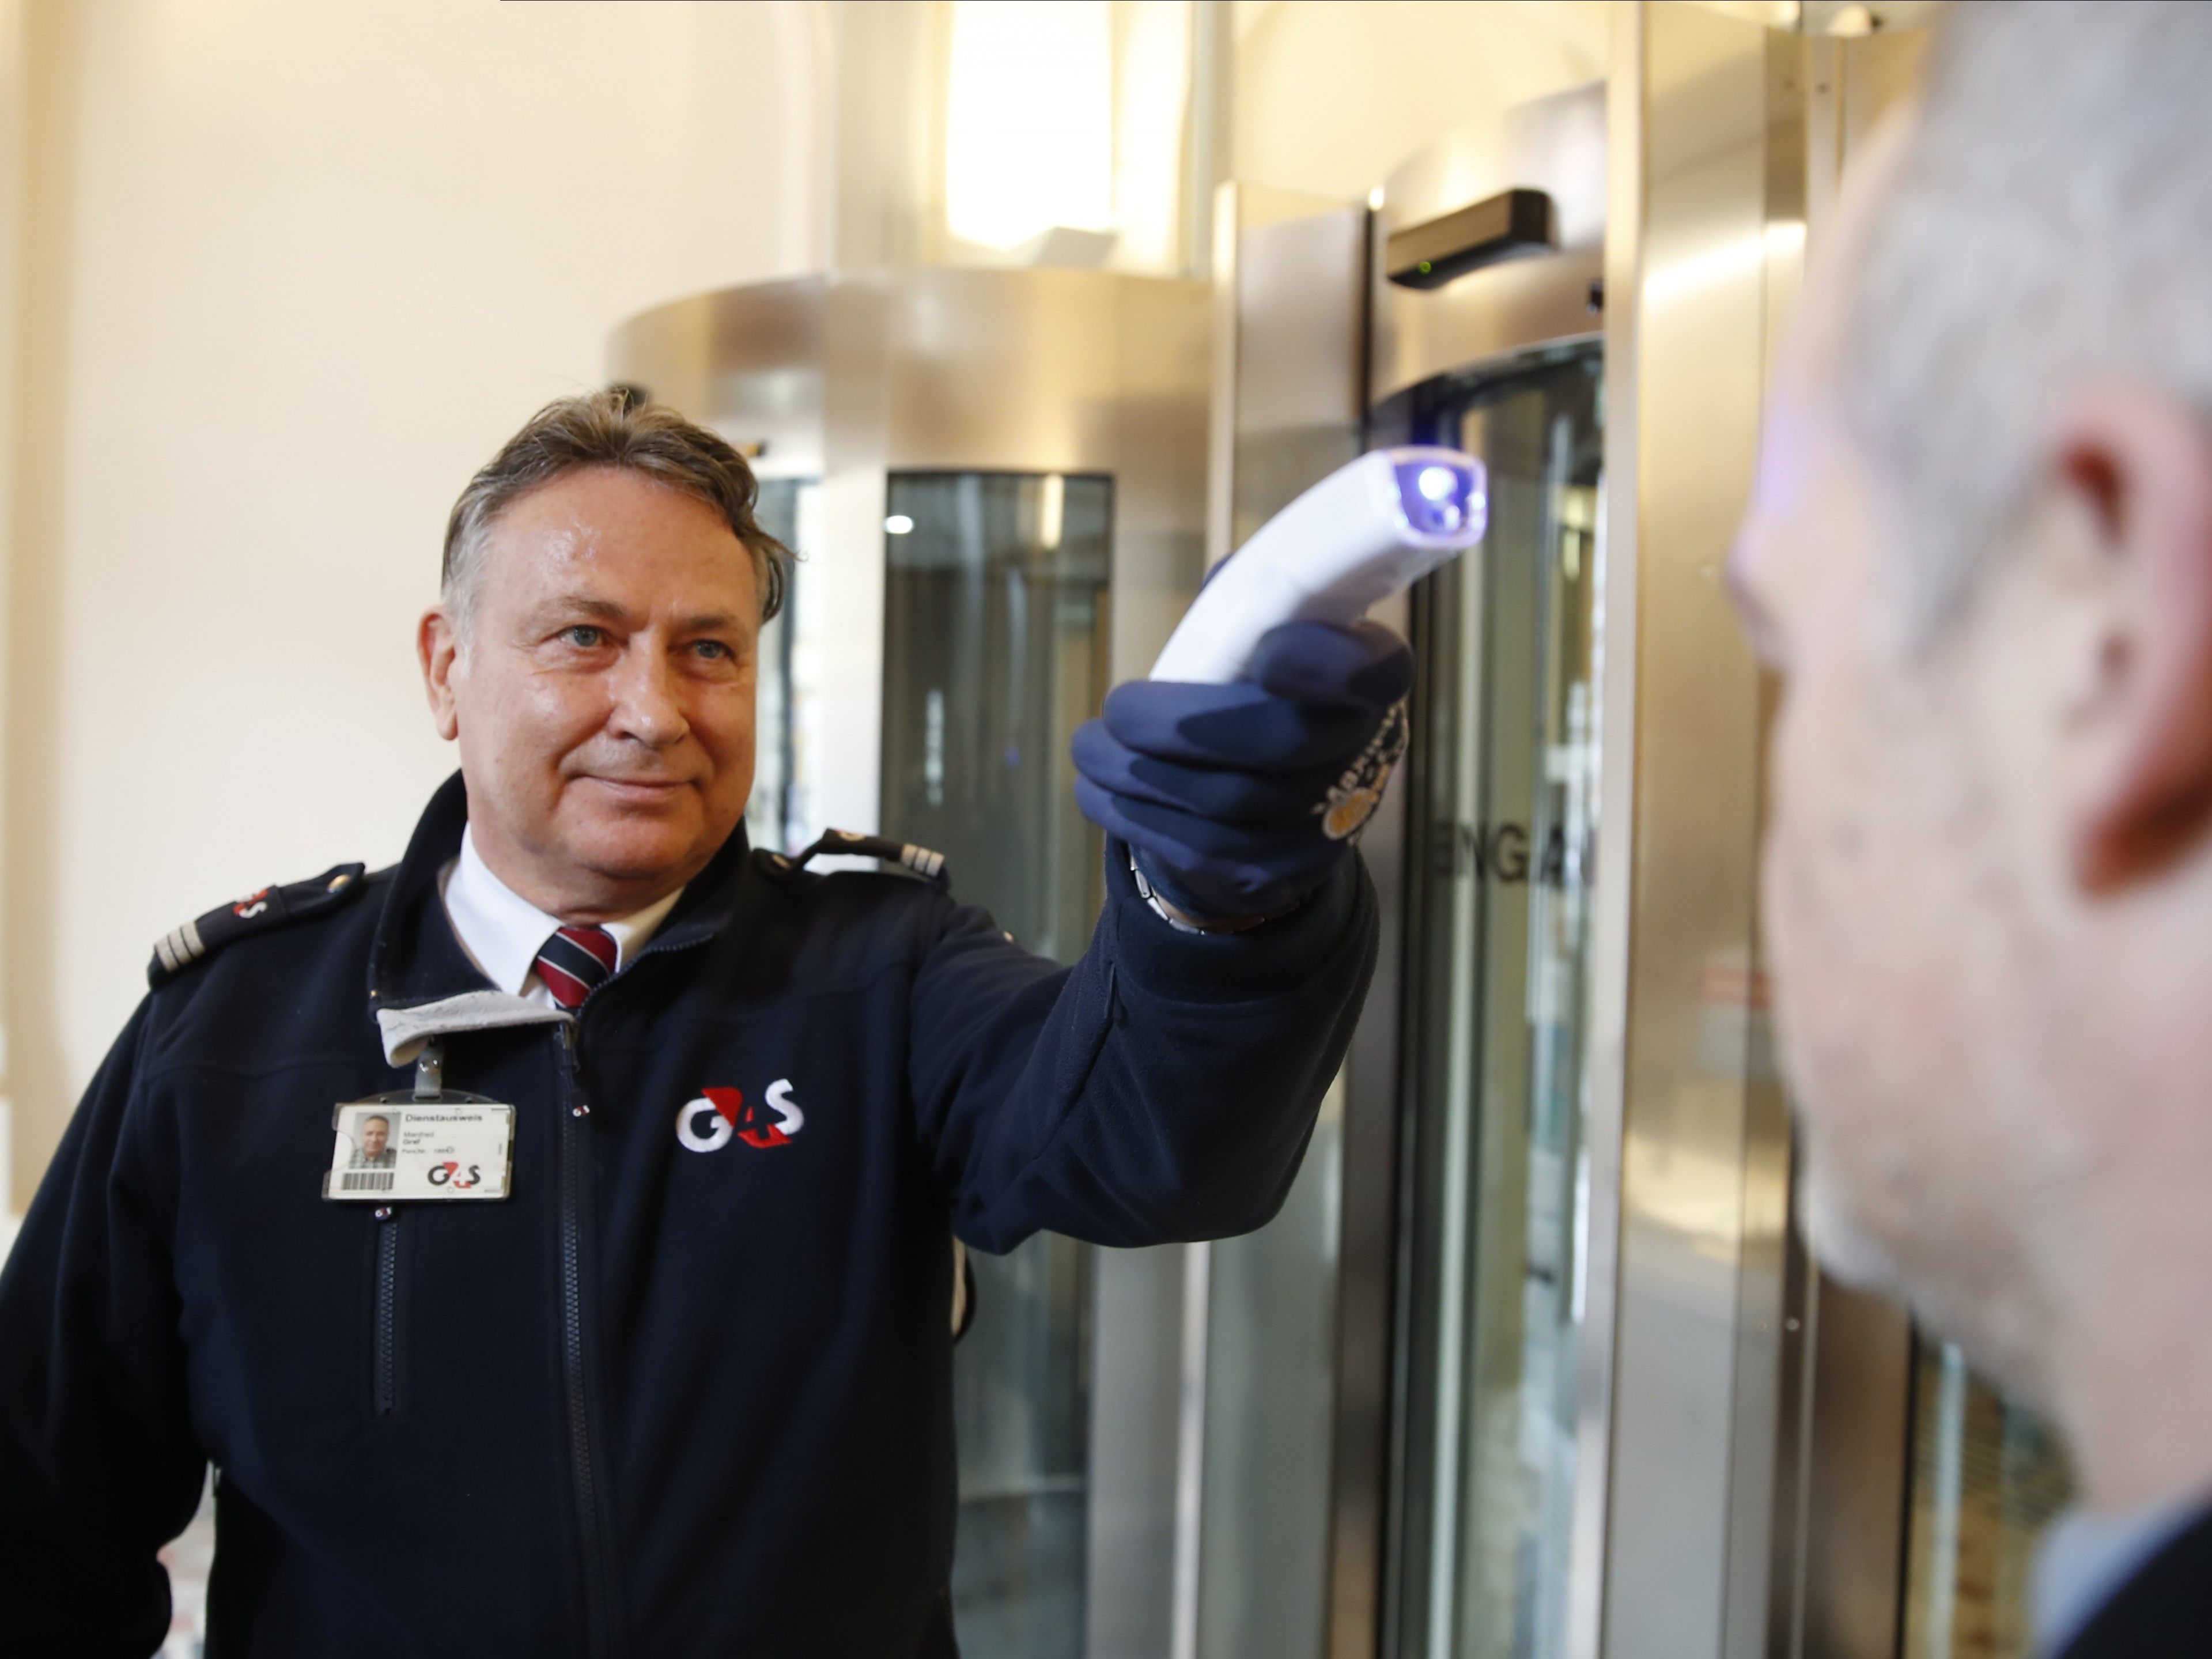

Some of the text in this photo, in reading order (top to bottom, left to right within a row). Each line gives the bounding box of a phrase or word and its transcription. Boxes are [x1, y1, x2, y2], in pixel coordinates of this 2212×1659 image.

[405, 1113, 483, 1123] Dienstausweis
[676, 1078, 804, 1152] G4S
[428, 1161, 481, 1189] G4S
